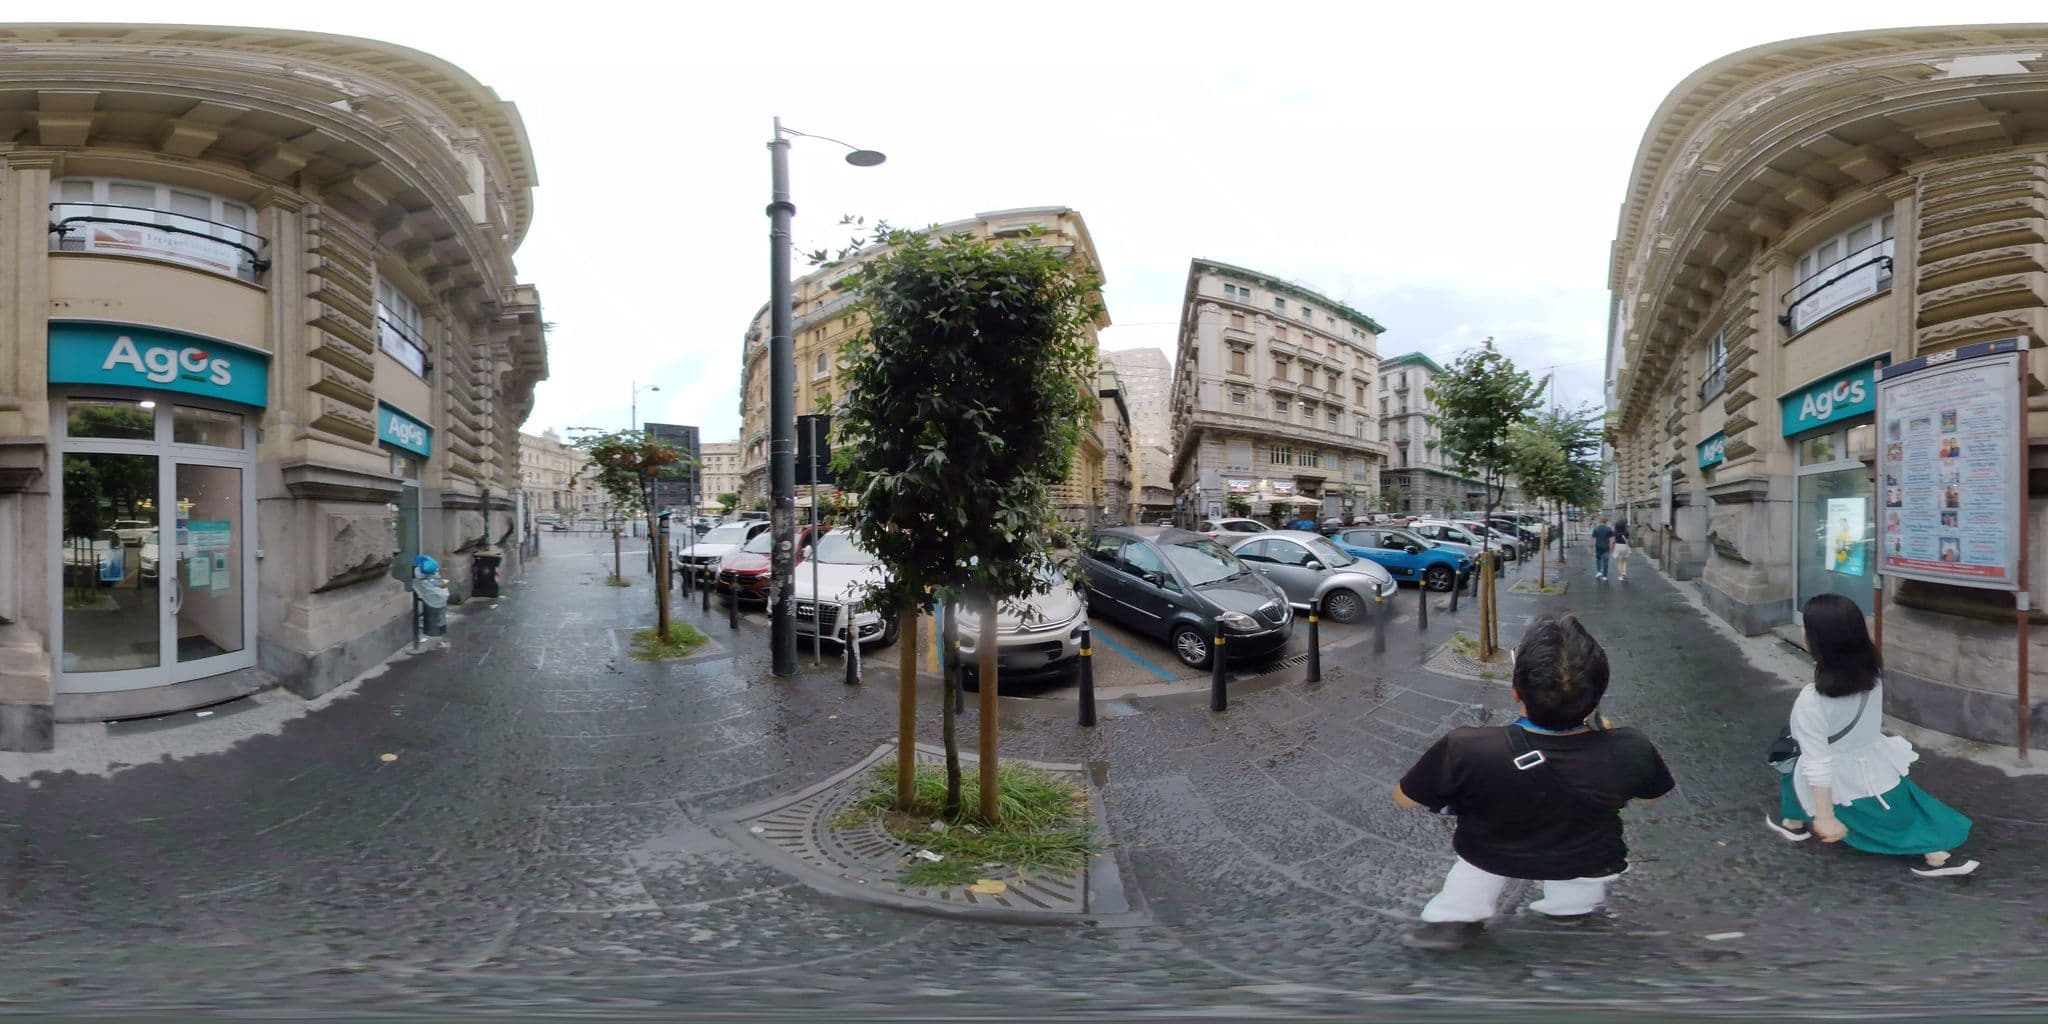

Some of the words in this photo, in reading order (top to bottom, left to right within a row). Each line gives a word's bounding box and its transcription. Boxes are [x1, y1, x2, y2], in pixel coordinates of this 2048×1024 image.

[102, 335, 232, 386] Agos
[1799, 379, 1866, 421] Agos
[388, 414, 423, 447] Agos
